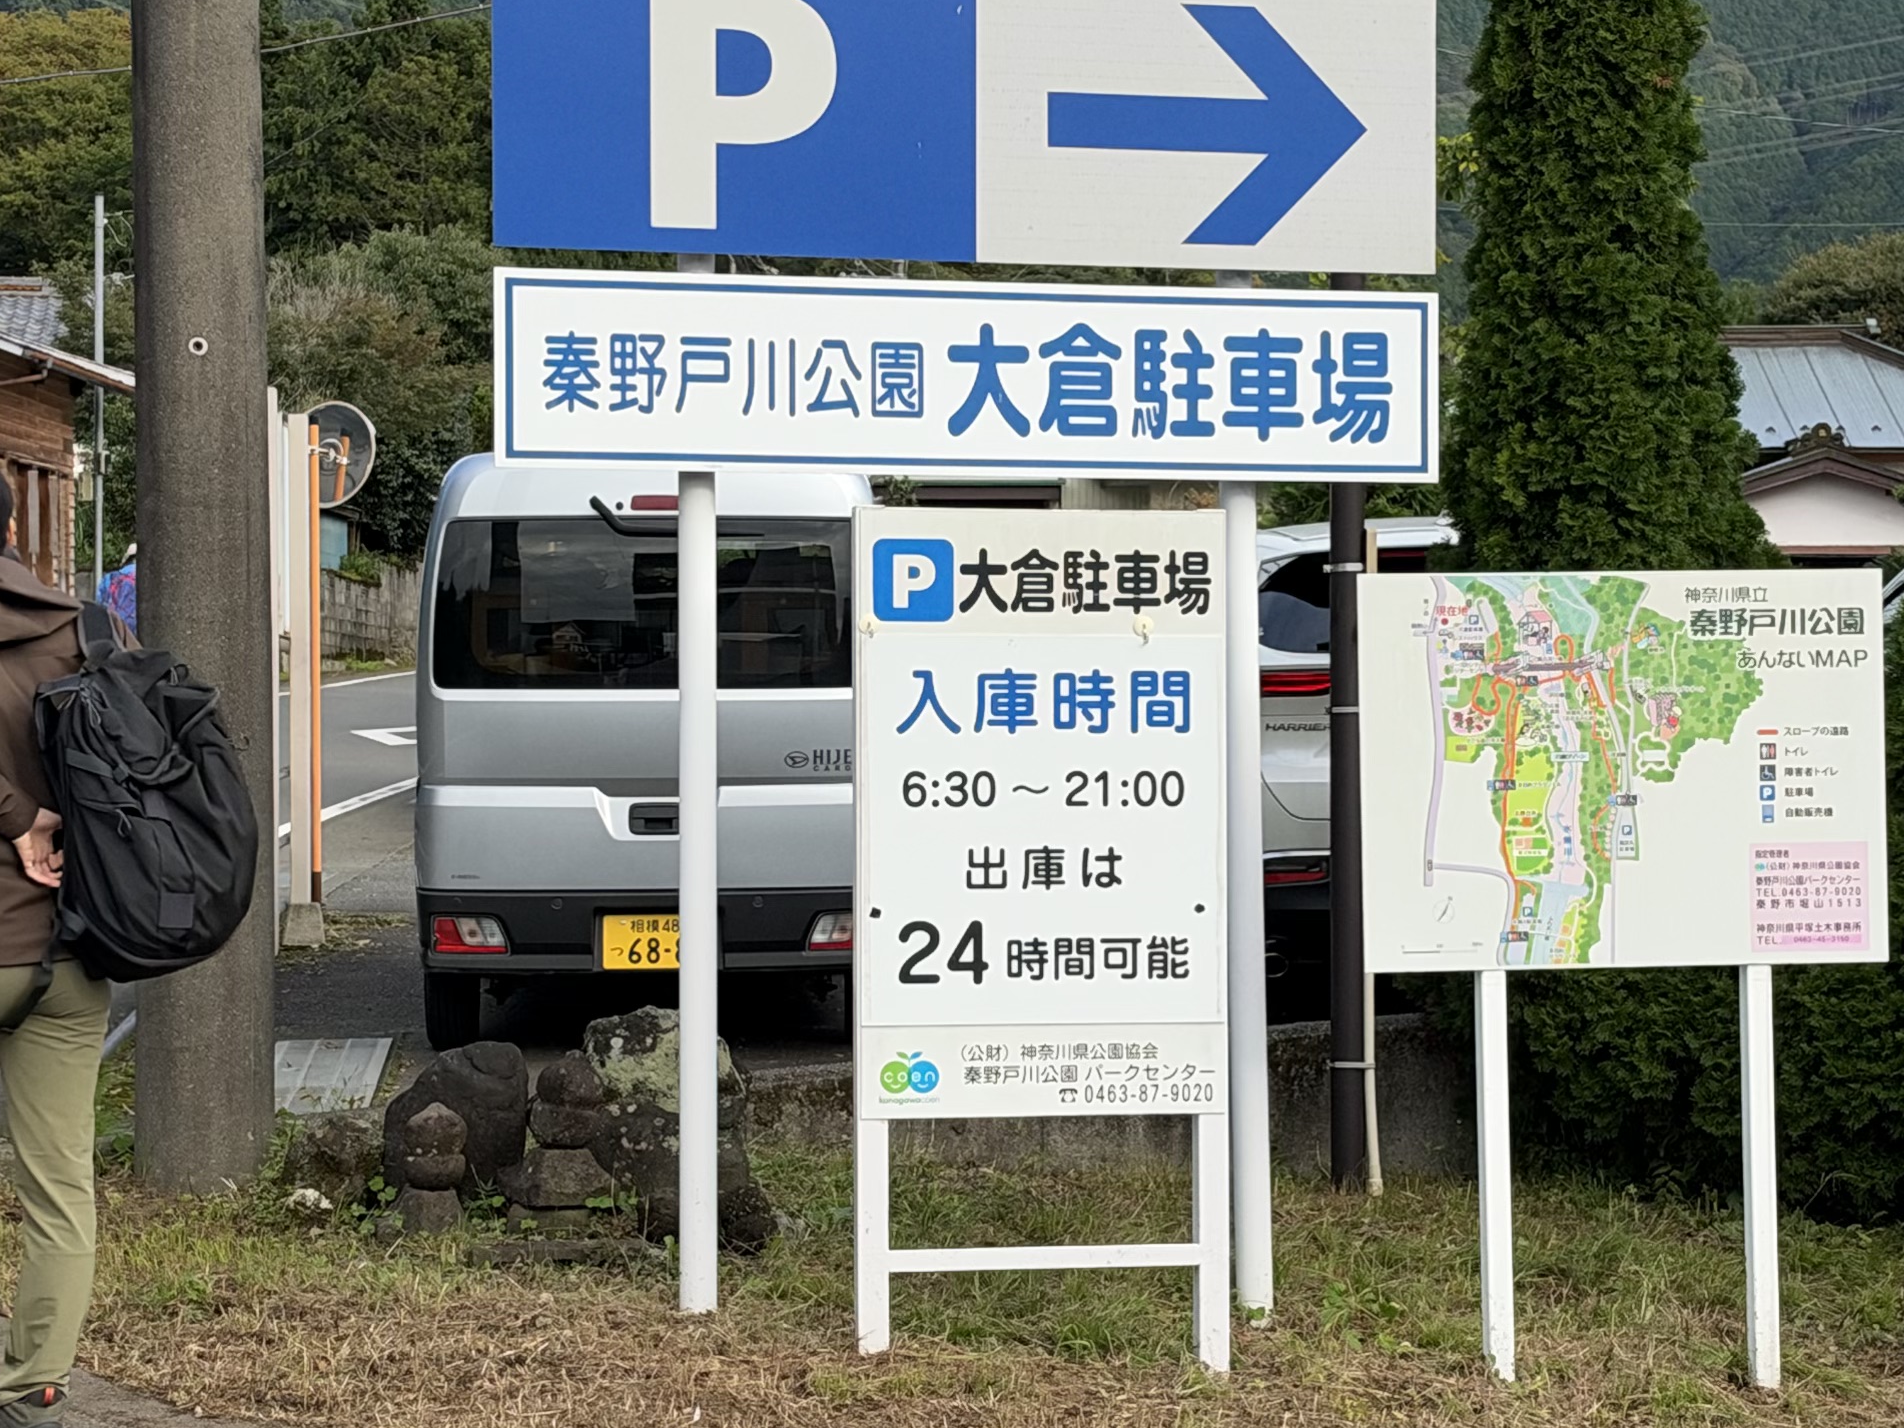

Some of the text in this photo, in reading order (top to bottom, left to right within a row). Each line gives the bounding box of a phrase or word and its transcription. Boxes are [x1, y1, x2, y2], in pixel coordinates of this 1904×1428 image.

[958, 547, 1212, 615] 大倉駐車場
[1684, 586, 1769, 604] 神奈川県立
[1689, 607, 1865, 636] 秦野戸川公園
[1737, 648, 1869, 669] あんないMAP
[896, 667, 1191, 735] 入庫時間
[1784, 746, 1809, 757] トイレ
[966, 845, 1123, 891] 出庫は
[627, 936, 680, 965] 68-
[1084, 1083, 1214, 1104] 0463-87-9020
